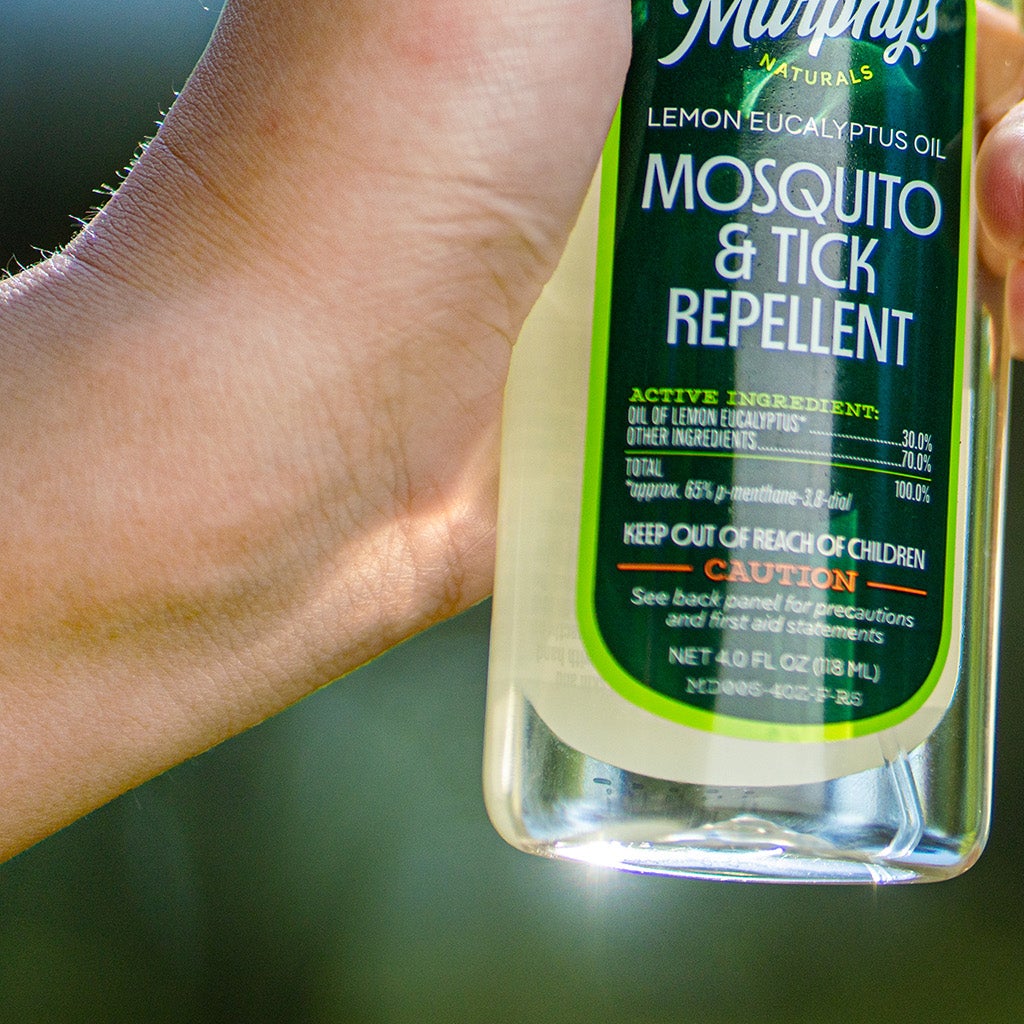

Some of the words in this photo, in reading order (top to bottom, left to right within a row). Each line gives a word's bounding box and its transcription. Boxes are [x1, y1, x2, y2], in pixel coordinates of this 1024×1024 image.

[760, 53, 873, 86] NATURALS
[648, 107, 740, 130] LEMON
[750, 110, 908, 150] EUCALYPTUS
[914, 134, 946, 160] OIL
[641, 153, 942, 236] MOSQUITO
[715, 222, 757, 280] &
[771, 226, 878, 294] TICK
[666, 287, 913, 366] REPELLENT
[628, 387, 719, 405] ACTIVE
[726, 390, 880, 420] INGREDIENT:
[626, 426, 669, 446] OTHER
[902, 450, 932, 473] 70.0%
[628, 406, 648, 425] OIL
[651, 406, 668, 425] OF
[671, 407, 718, 426] LEMON
[902, 429, 932, 452] 30.0%
[625, 457, 663, 477] TOTAL
[894, 480, 930, 504] 100.0%
[685, 479, 713, 500] 65%
[623, 522, 669, 545] KEEP
[671, 523, 716, 547] OUT
[719, 526, 750, 549] OF
[753, 527, 815, 555] REACH
[816, 533, 847, 557] OF
[847, 537, 925, 570] CHILDREN
[704, 558, 859, 593] CAUTION
[630, 586, 670, 606] See
[672, 587, 722, 608] back
[723, 593, 783, 613] panel
[785, 594, 814, 614] for
[813, 602, 915, 628] precautions
[665, 609, 708, 628] and
[709, 610, 750, 631] first
[750, 614, 786, 634] aid
[786, 619, 884, 645] statements
[668, 646, 712, 666] NET
[751, 650, 777, 670] FL
[779, 653, 811, 673] OZ
[812, 656, 845, 676] (118
[847, 661, 881, 684] ML)
